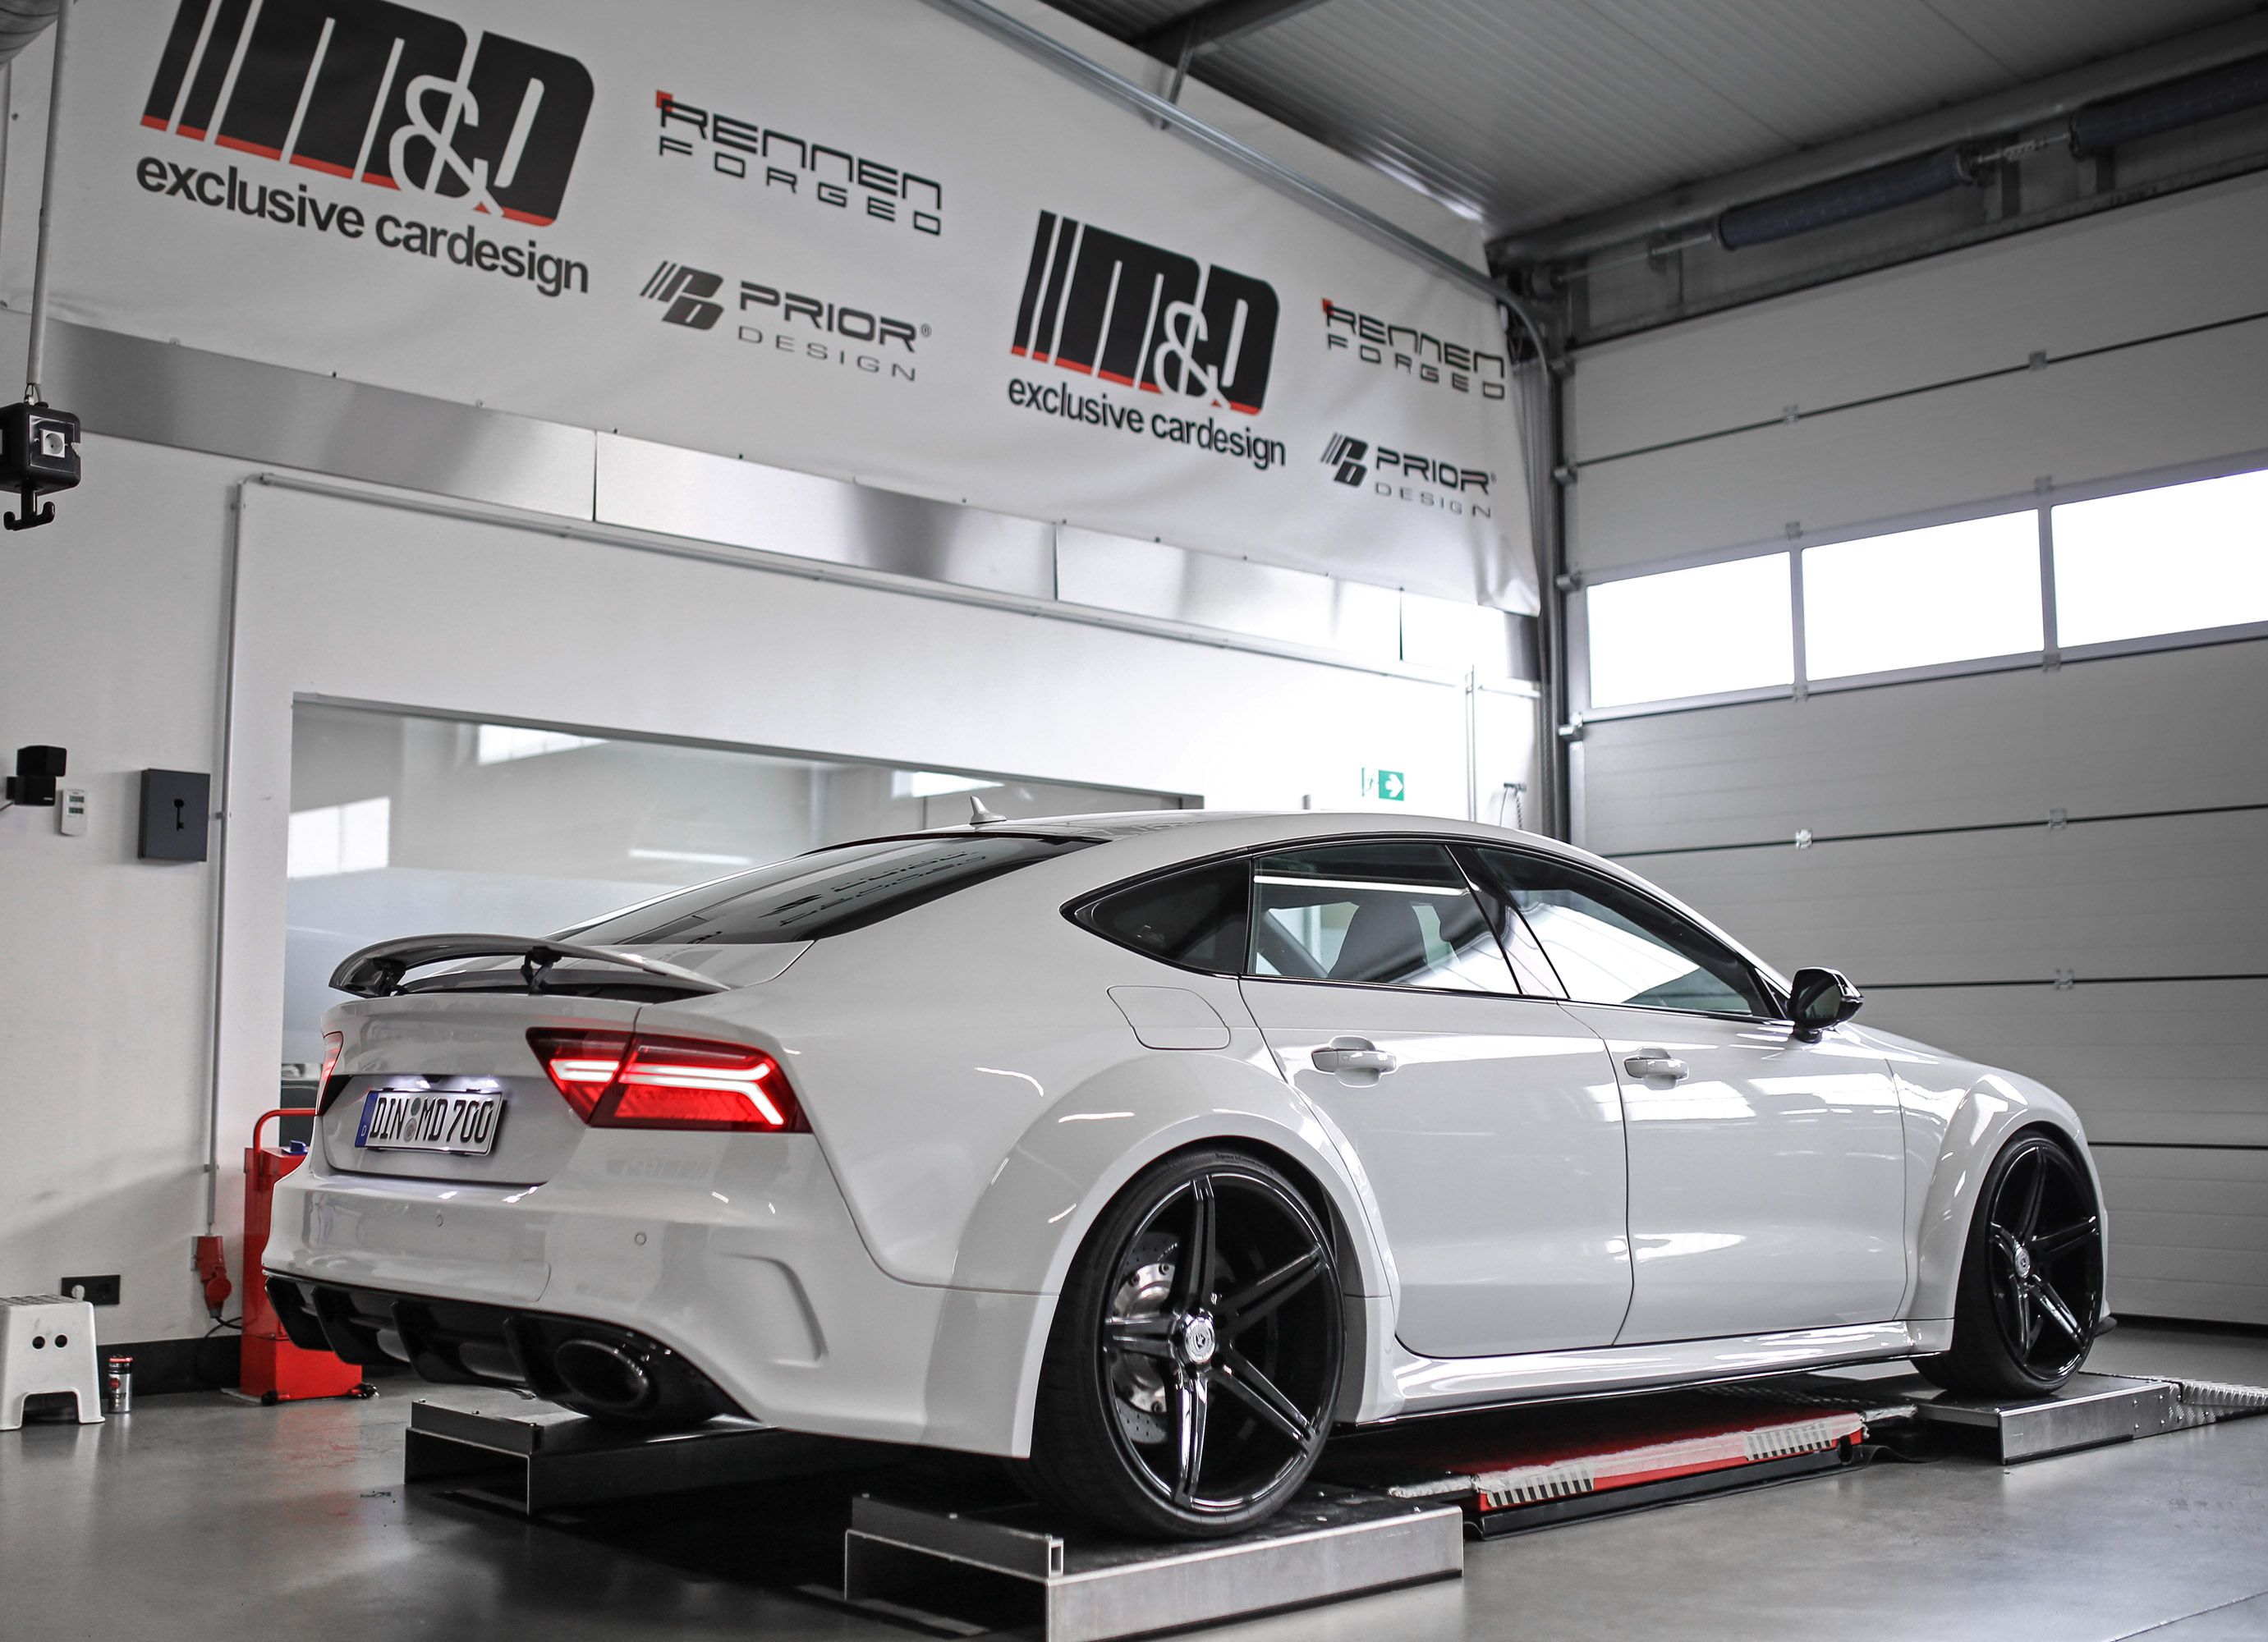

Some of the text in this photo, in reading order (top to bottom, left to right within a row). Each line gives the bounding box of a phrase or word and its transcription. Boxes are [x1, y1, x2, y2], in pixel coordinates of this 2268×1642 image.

[659, 94, 943, 210] RENNEN
[659, 135, 942, 236] FORGED
[136, 156, 589, 297] exclusive cardesign
[737, 326, 916, 381] DESIGN
[1327, 333, 1505, 401] FORGED
[1008, 377, 1286, 470] exclusive cardesign
[1375, 482, 1491, 519] DESIGN
[370, 1097, 494, 1144] DIN MD 700
